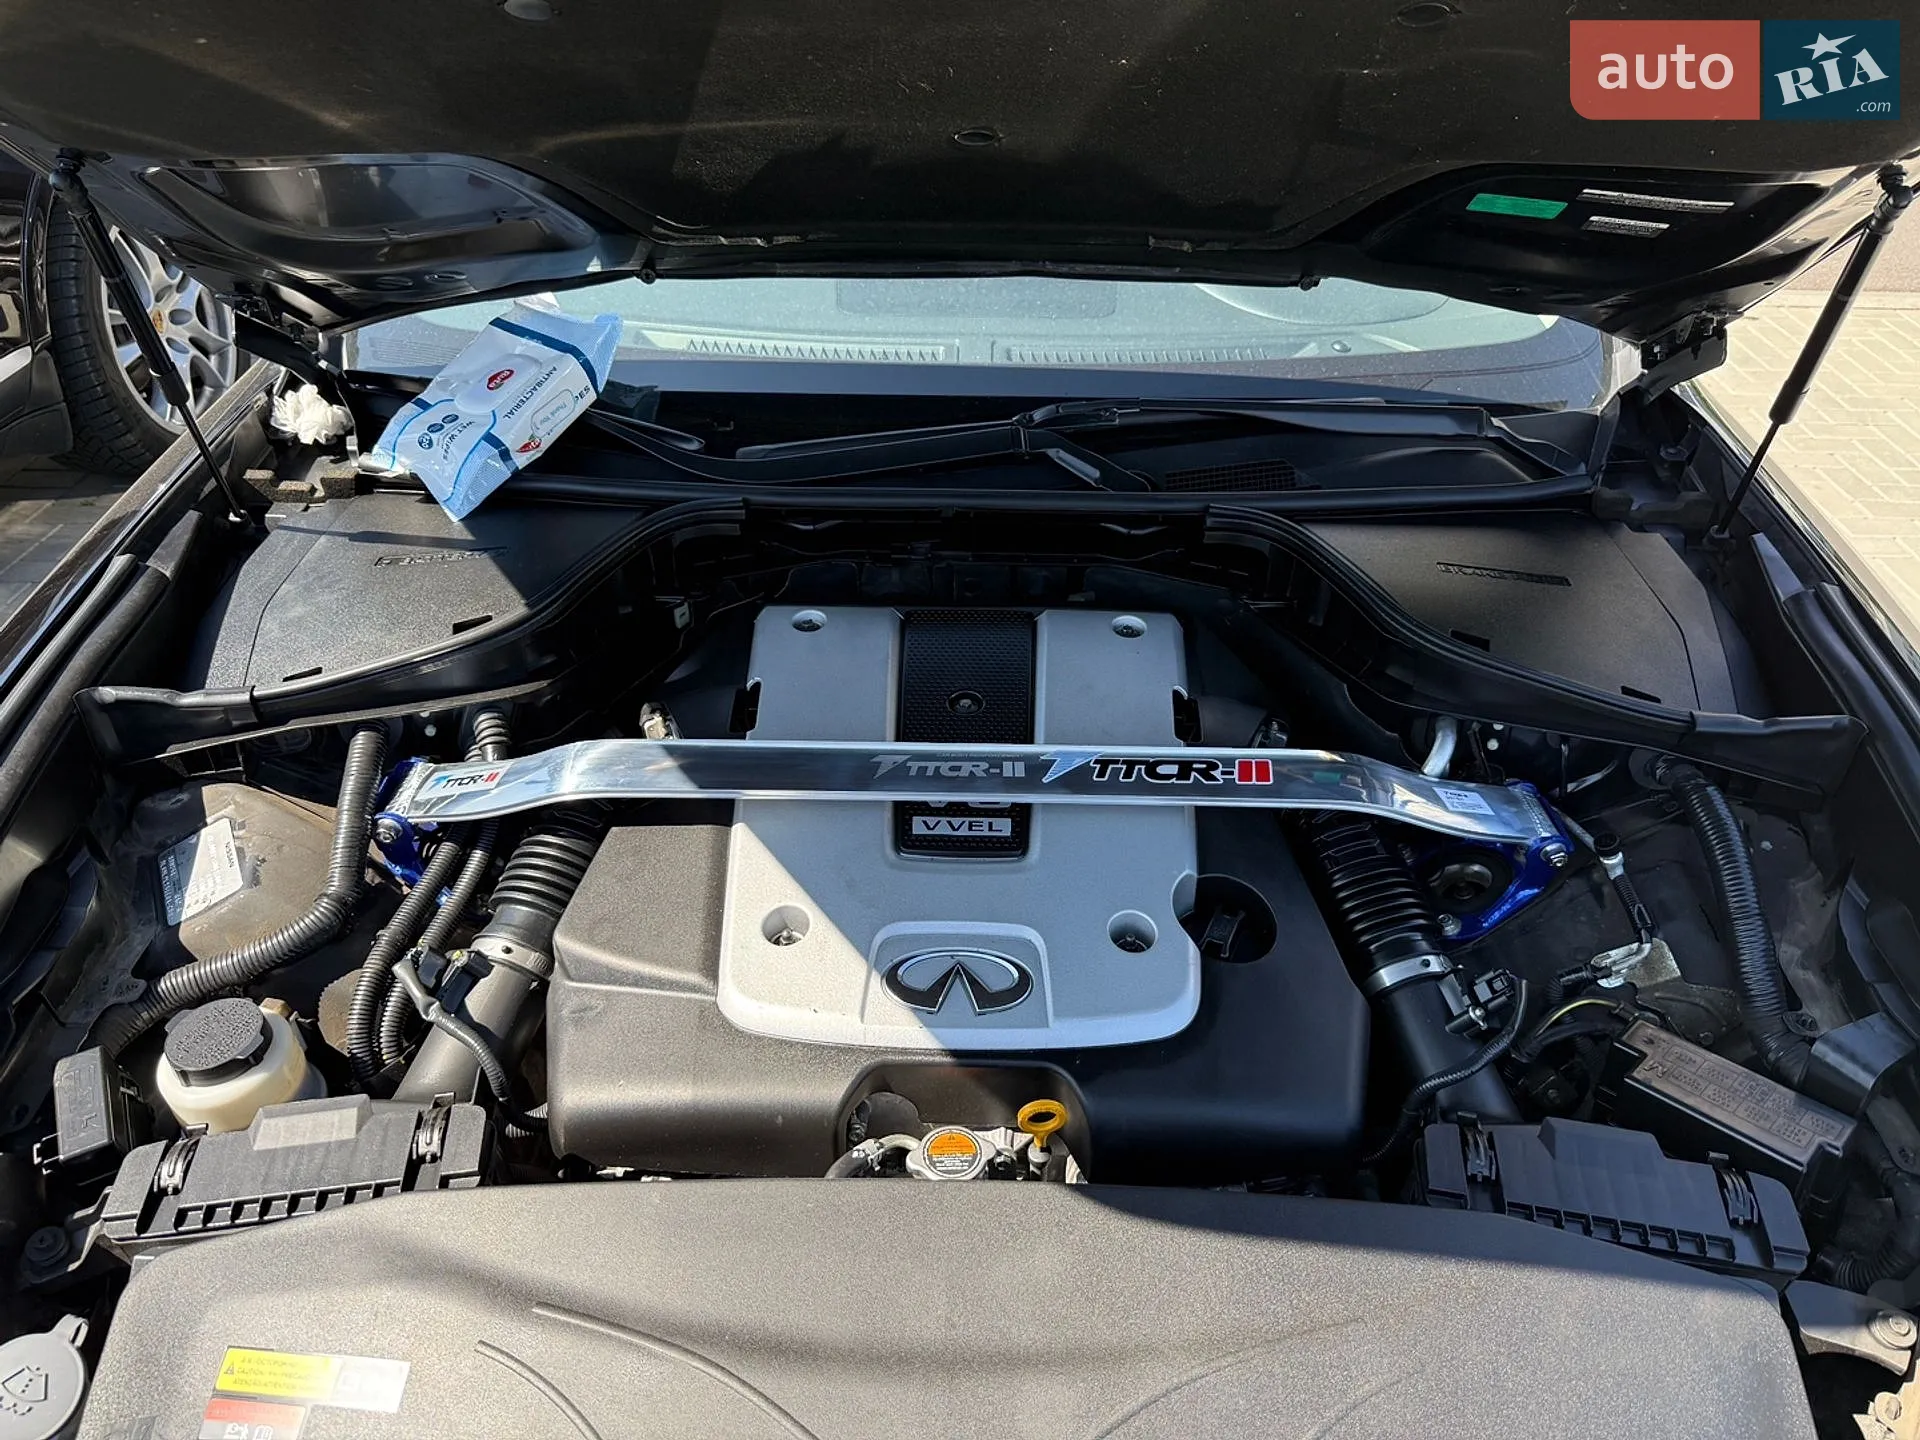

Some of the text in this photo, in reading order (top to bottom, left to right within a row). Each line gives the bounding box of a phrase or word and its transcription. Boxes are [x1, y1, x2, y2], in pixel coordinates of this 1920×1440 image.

[502, 366, 558, 420] ANTIBACTERIAL
[457, 420, 477, 434] WET
[905, 760, 1026, 778] TTCR-II
[1089, 757, 1274, 785] TTCR-II
[442, 771, 500, 789] TTCR-II
[921, 819, 1003, 833] VVEL
